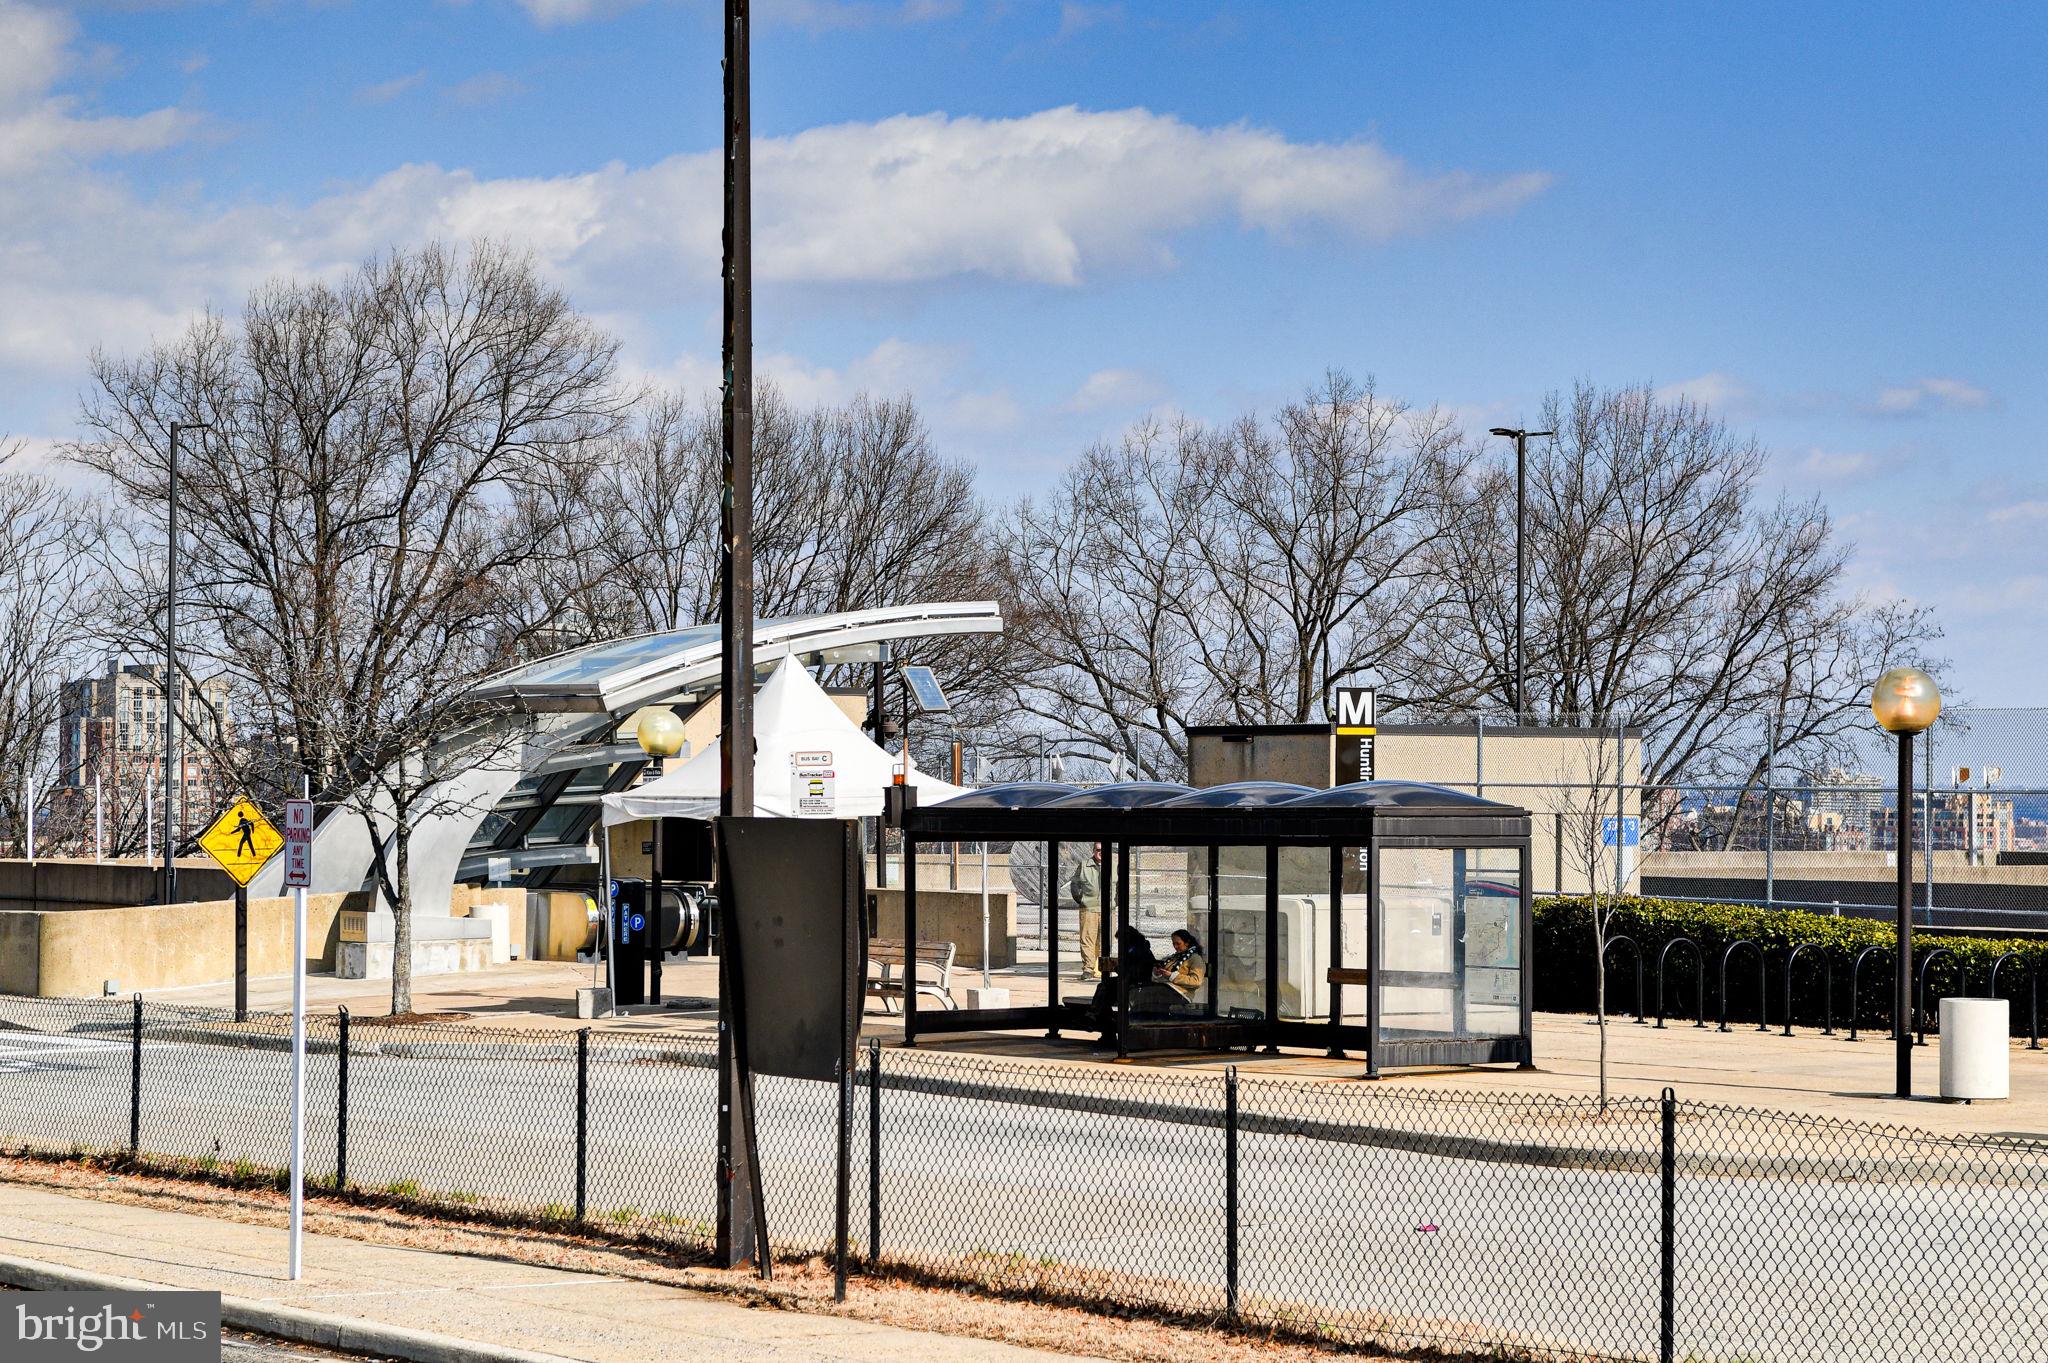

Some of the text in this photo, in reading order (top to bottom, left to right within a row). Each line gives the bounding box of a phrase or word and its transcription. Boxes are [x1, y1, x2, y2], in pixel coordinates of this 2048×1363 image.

[1339, 691, 1373, 725] M
[293, 808, 304, 825] NO
[287, 827, 311, 844] PARKING
[293, 845, 304, 856] ANY
[292, 858, 304, 869] TIME
